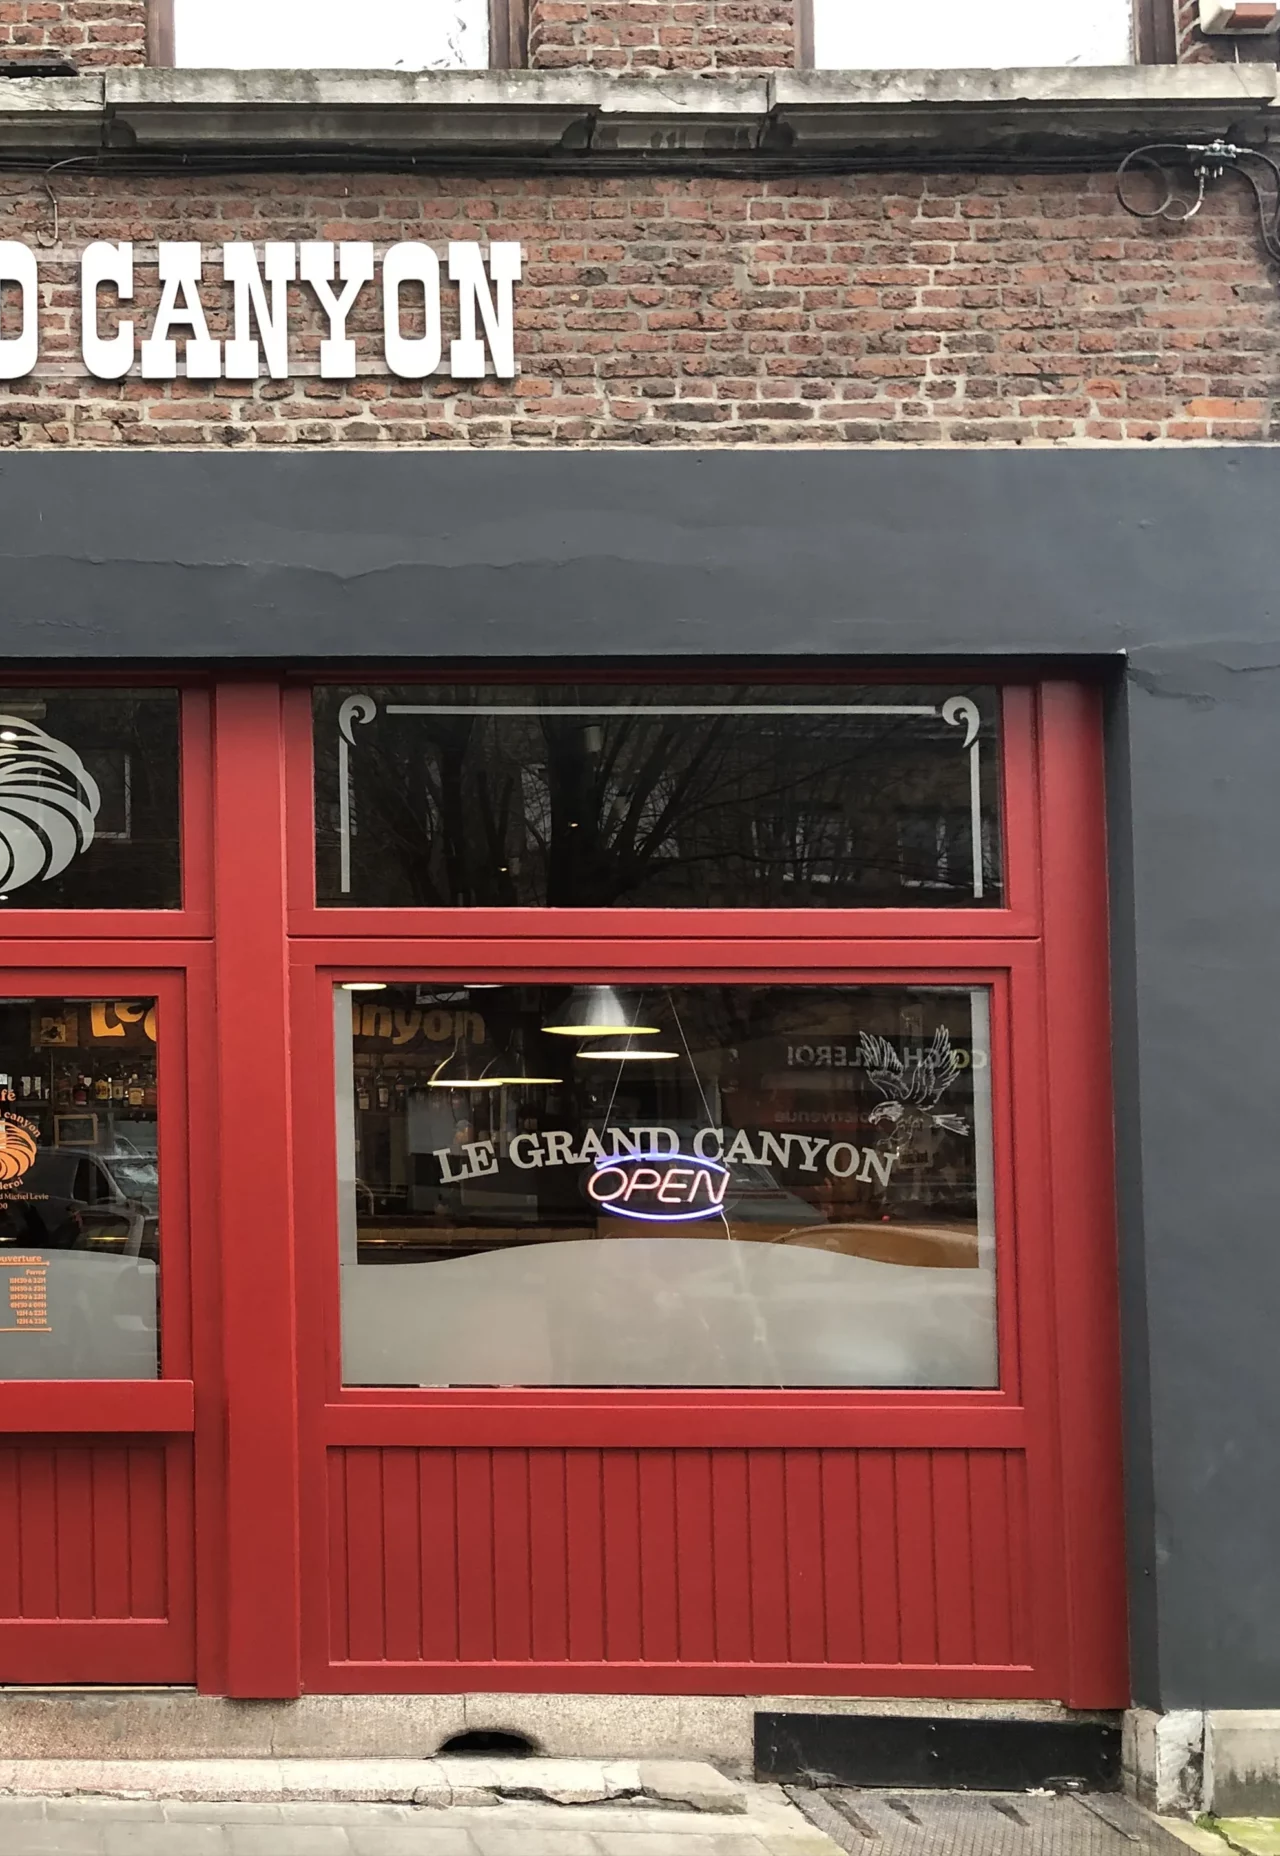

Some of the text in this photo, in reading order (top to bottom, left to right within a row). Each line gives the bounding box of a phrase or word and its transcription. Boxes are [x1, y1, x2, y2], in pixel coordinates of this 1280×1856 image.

[81, 240, 522, 380] CANYON
[4, 1111, 41, 1138] canyon
[433, 1127, 900, 1187] LE GRAND CANYON
[587, 1166, 731, 1204] OPEN
